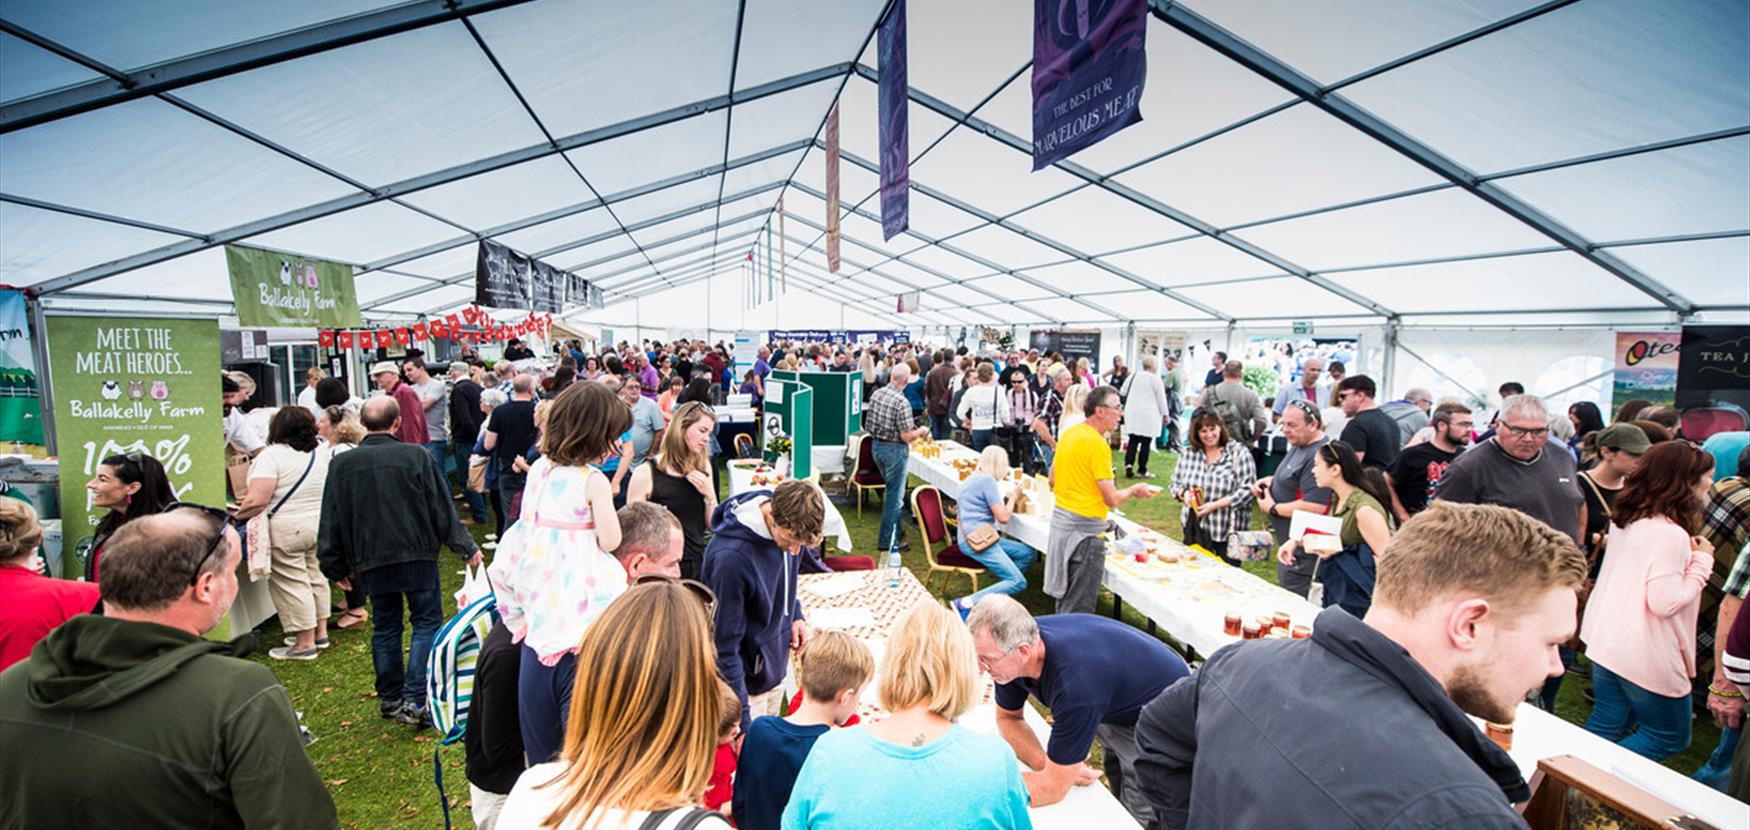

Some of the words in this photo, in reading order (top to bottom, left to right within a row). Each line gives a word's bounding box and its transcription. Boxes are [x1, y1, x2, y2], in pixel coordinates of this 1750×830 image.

[1054, 101, 1069, 119] THE
[1070, 88, 1092, 110] BEST
[1094, 77, 1113, 97] FOR
[1034, 108, 1100, 157] MARVELOUS
[1101, 85, 1139, 122] MEAT
[258, 282, 310, 316] Ballakelly
[313, 290, 336, 310] Farm
[97, 328, 142, 351] MEET
[145, 327, 173, 350] THE
[76, 352, 123, 375] MEAT
[126, 352, 193, 375] HEROES...
[1699, 351, 1735, 362] TEA
[70, 400, 153, 422] Ballakelly
[159, 401, 205, 417] Farm
